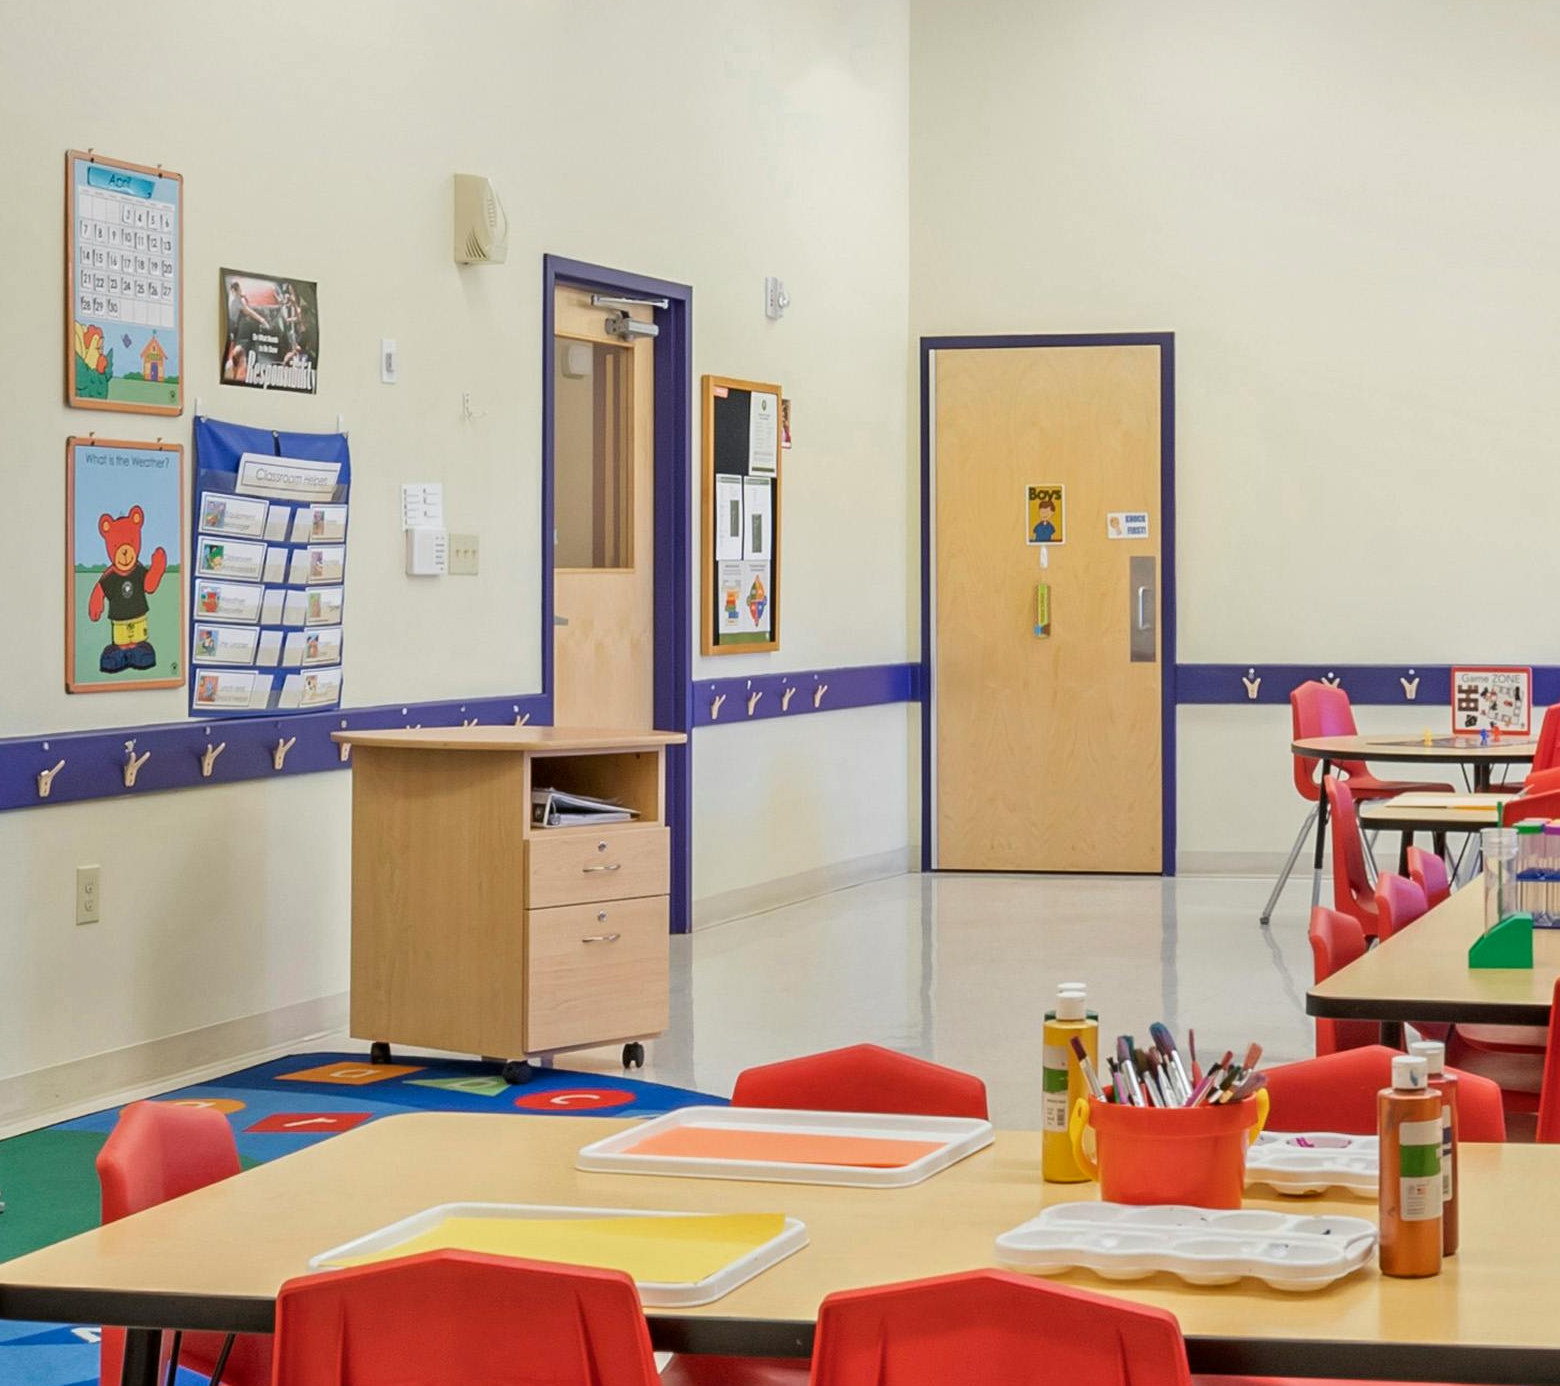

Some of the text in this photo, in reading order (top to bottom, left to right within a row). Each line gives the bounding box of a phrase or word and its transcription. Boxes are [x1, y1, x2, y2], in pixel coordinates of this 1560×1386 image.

[245, 350, 316, 394] Responsibility
[1028, 487, 1062, 502] Boys
[1462, 673, 1521, 683] Game ZONE
